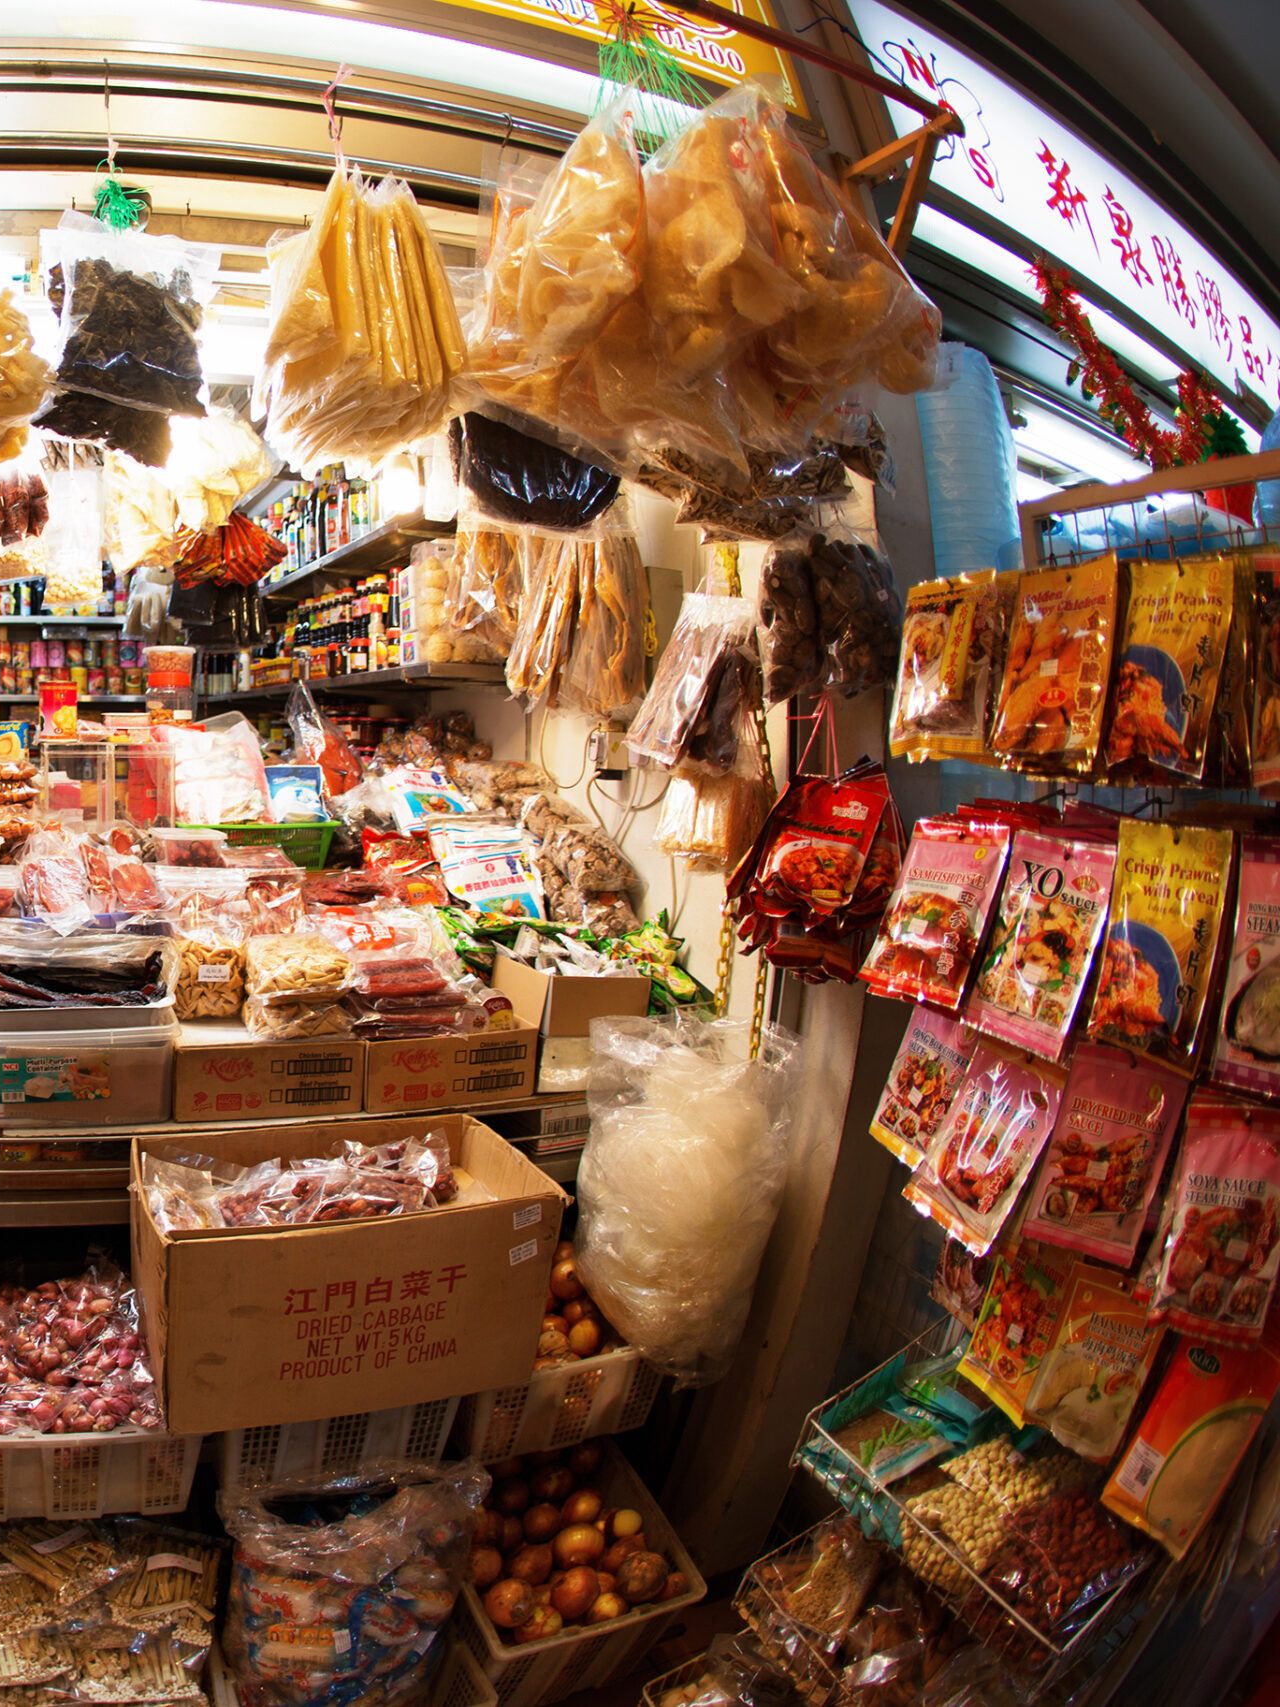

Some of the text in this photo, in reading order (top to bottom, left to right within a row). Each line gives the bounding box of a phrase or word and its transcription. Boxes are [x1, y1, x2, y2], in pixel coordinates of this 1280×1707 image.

[654, 22, 746, 75] 01-100
[933, 869, 956, 884] FISH
[1015, 860, 1065, 900] XO
[1124, 857, 1164, 883] Crispy
[1169, 863, 1221, 885] Prawns
[1060, 892, 1099, 913] SAUCE
[1142, 884, 1171, 899] with
[1071, 1097, 1096, 1114] DRY
[1094, 1102, 1128, 1123] FRIED
[1067, 1114, 1104, 1136] SAUCE
[1187, 1173, 1266, 1195] SOYA SAUCE
[1221, 1193, 1247, 1210] FISH
[283, 1263, 469, 1317] 江門白菜干
[295, 1301, 448, 1341] DRIED CABBAGE
[305, 1334, 343, 1359] NET
[278, 1338, 459, 1382] PRODUCT OF CHINA
